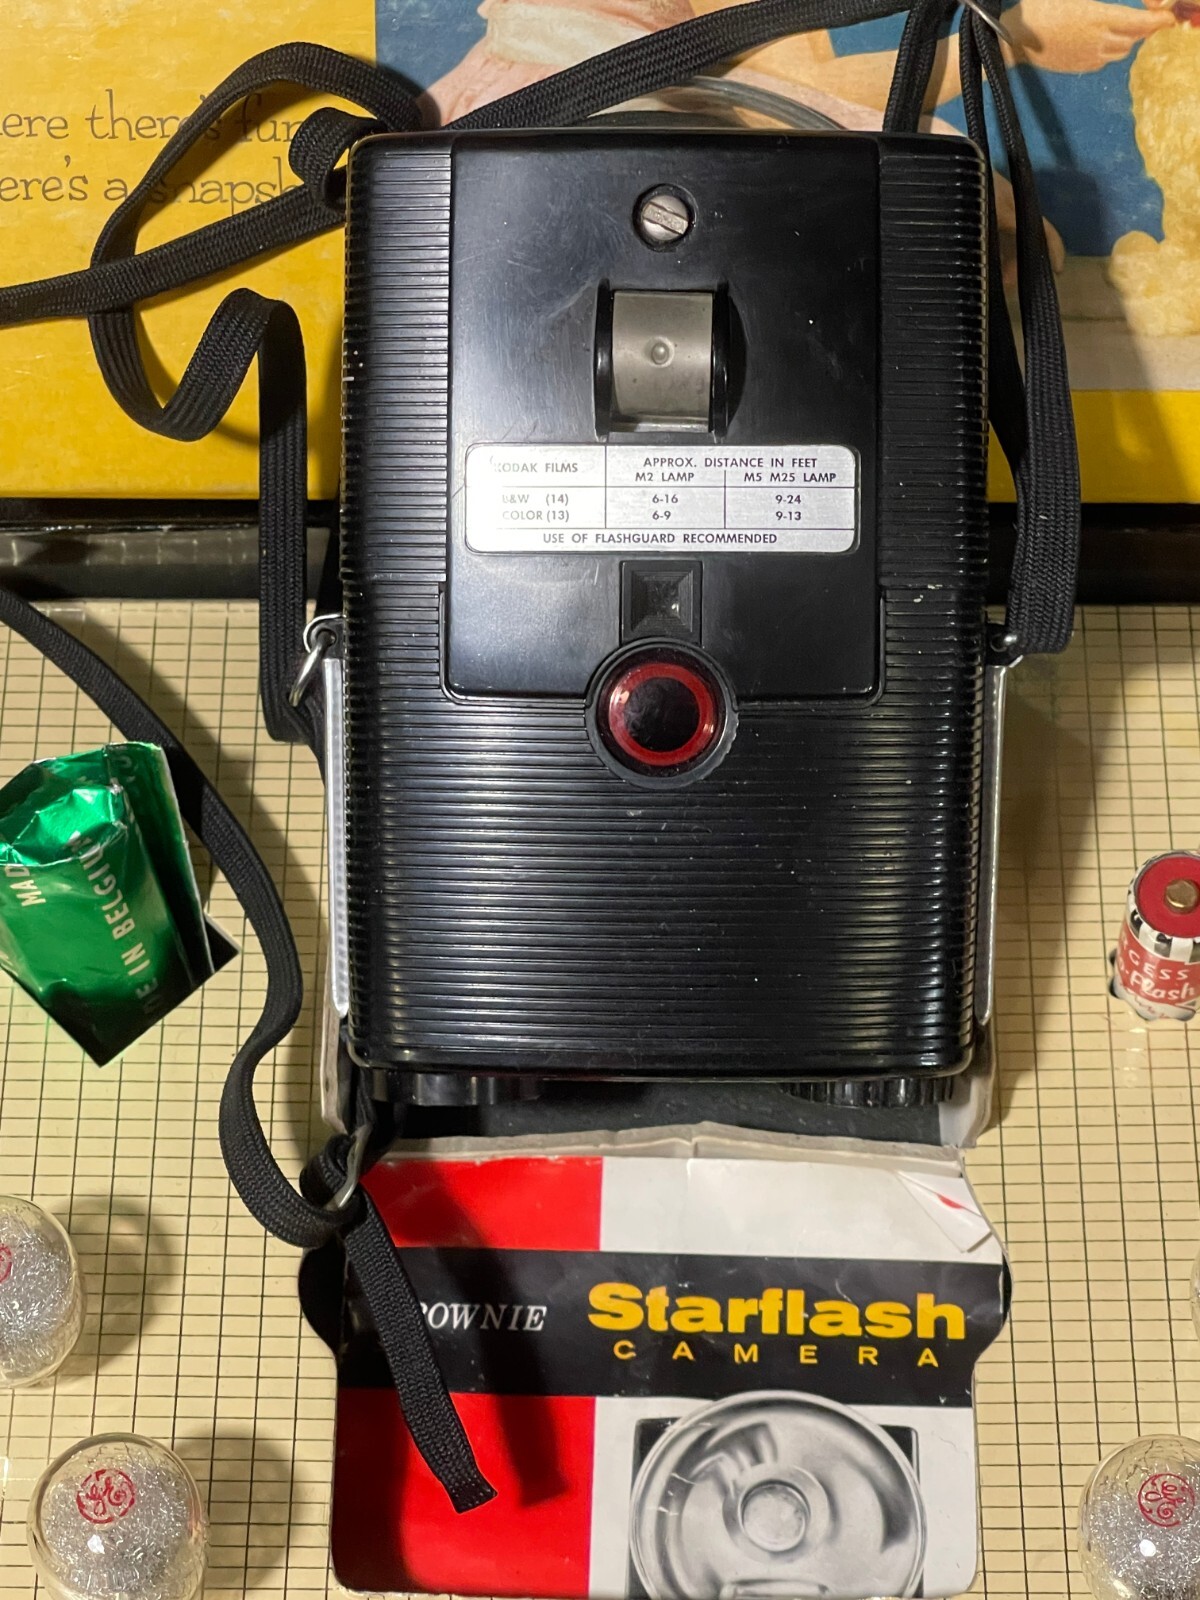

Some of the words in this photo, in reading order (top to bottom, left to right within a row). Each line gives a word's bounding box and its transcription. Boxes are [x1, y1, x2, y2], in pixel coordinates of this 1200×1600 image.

[0, 112, 69, 140] ere
[103, 178, 129, 201] a
[545, 462, 579, 473] FILMS
[643, 457, 697, 468] APPROX.
[704, 457, 764, 468] DISTANCE
[771, 458, 785, 468] IN
[791, 458, 818, 468] FEET
[635, 472, 654, 482] M2
[661, 472, 695, 482] LAMP
[744, 472, 763, 482] M5
[769, 472, 796, 482] M25
[803, 472, 837, 483] LAMP
[545, 493, 569, 507] (14)
[652, 494, 679, 504] 6-16
[775, 494, 802, 505] 9-24
[502, 510, 543, 521] COLOR
[546, 509, 570, 523] (13)
[652, 511, 672, 521] 6-9
[775, 511, 802, 521] 9-13
[543, 533, 565, 544] USE
[571, 533, 589, 544] OF
[595, 533, 676, 544] FLASHGUARD
[683, 533, 777, 544] RECOMMENDED
[121, 942, 150, 976] IN
[587, 1281, 966, 1341] Starflash
[613, 1339, 939, 1367] CAMERA
